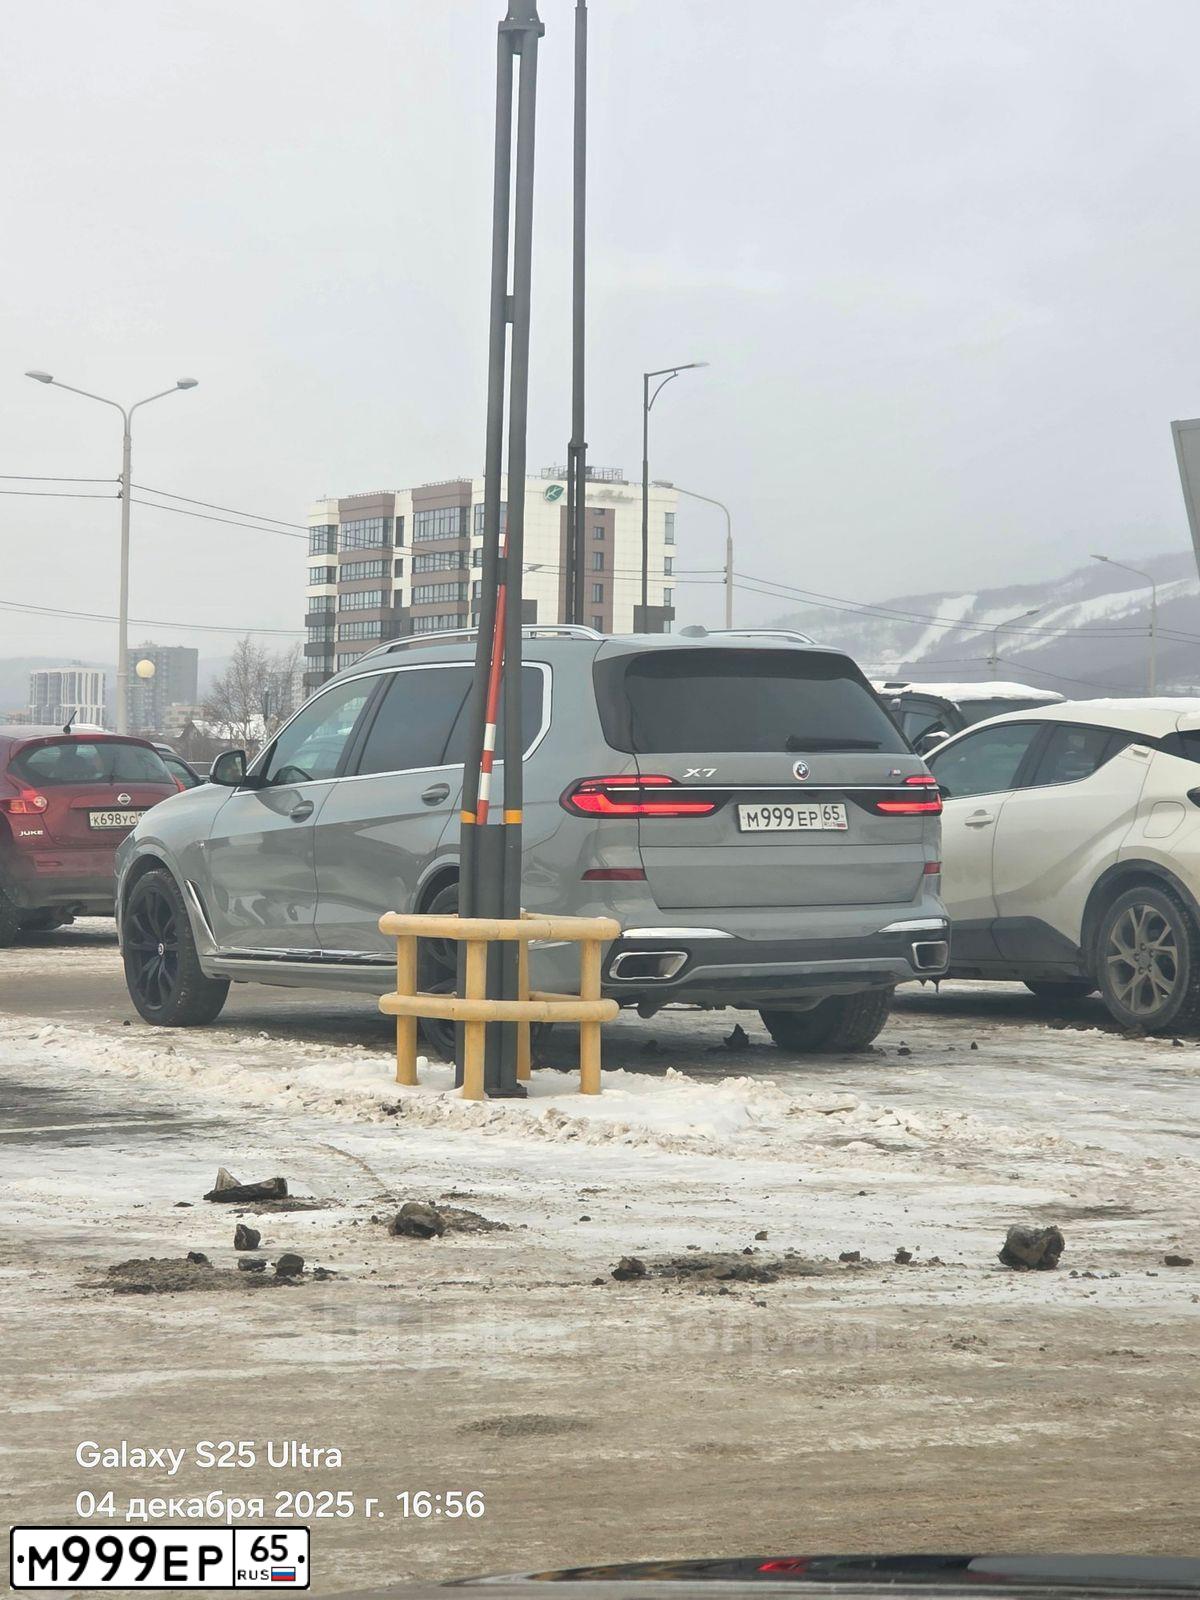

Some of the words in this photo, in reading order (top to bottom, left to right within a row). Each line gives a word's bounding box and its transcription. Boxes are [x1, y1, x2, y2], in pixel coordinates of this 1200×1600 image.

[682, 768, 718, 778] X7
[93, 813, 137, 826] К698УС
[746, 807, 818, 827] М999ЕР
[823, 805, 840, 820] 65
